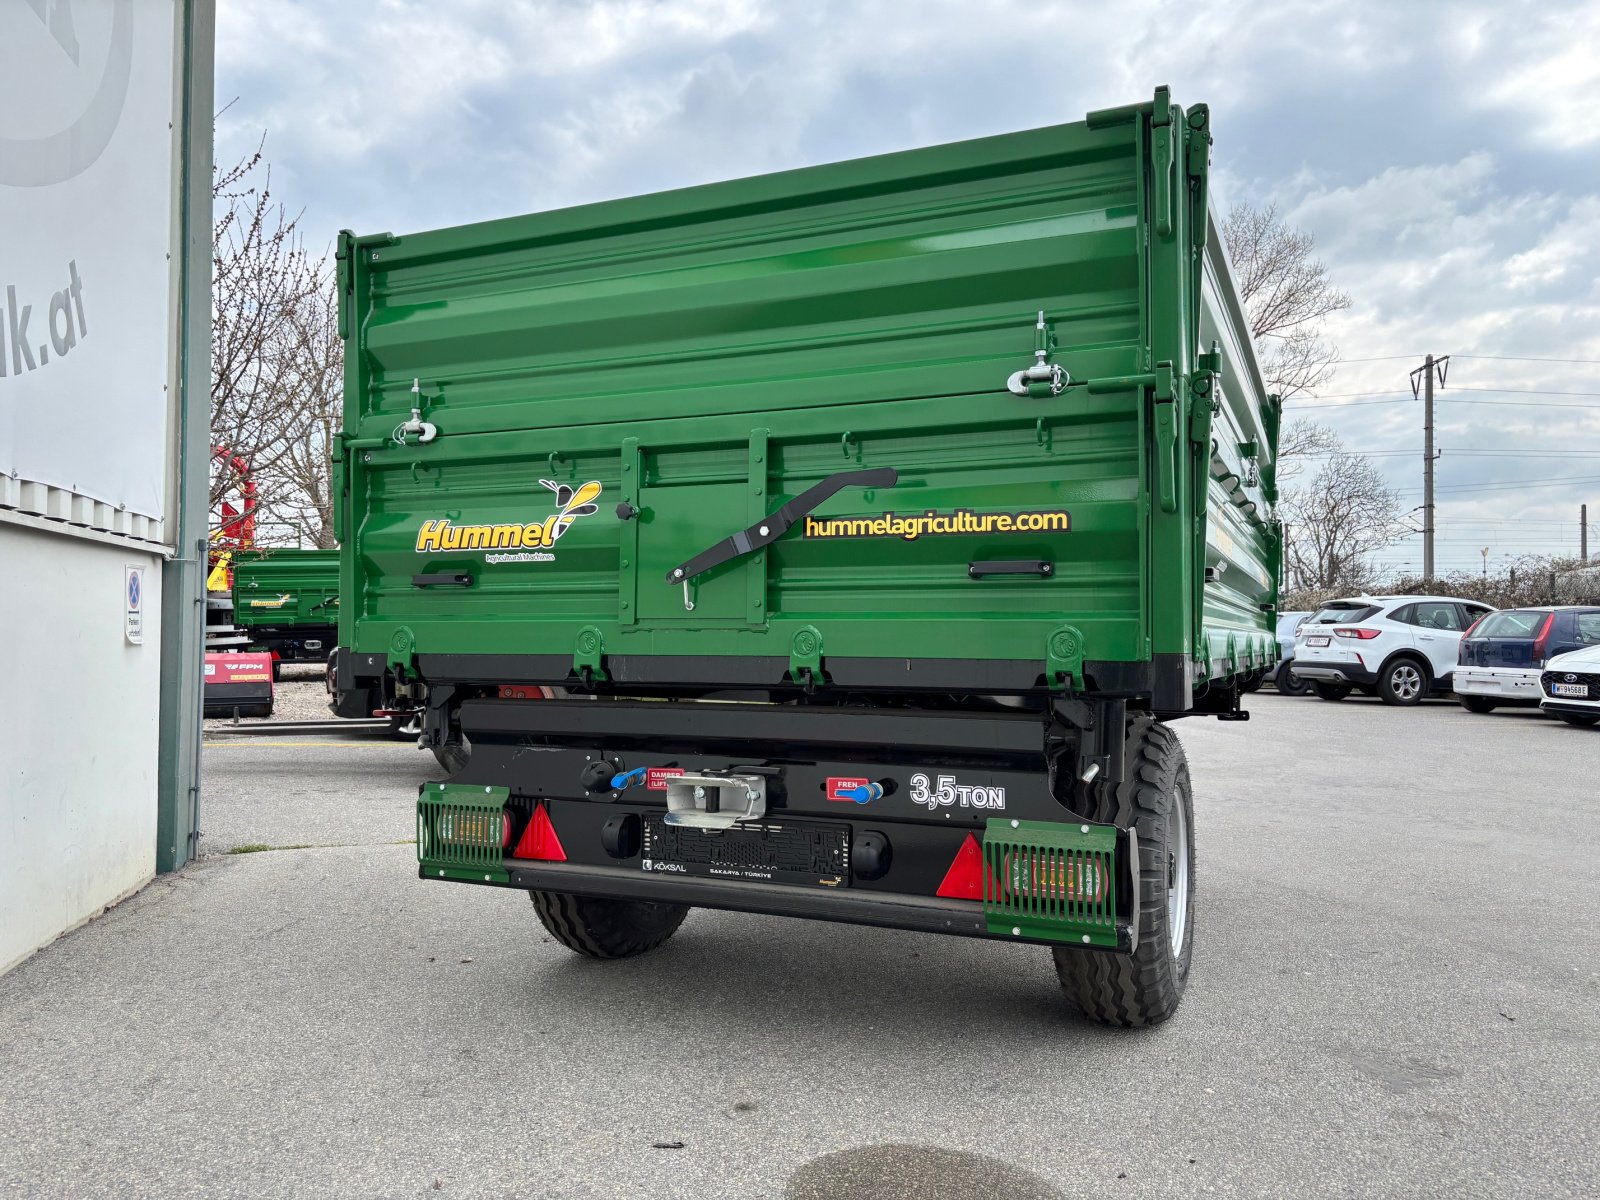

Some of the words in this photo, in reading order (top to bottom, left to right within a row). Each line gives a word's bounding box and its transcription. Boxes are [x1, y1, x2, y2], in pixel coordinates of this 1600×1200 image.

[805, 511, 1068, 539] hummelagriculture.com
[416, 515, 556, 552] Hummel
[486, 553, 522, 563] Agricultural
[524, 552, 555, 561] Machines
[653, 861, 687, 872] KÖKSAL
[709, 868, 740, 876] SAKARYA
